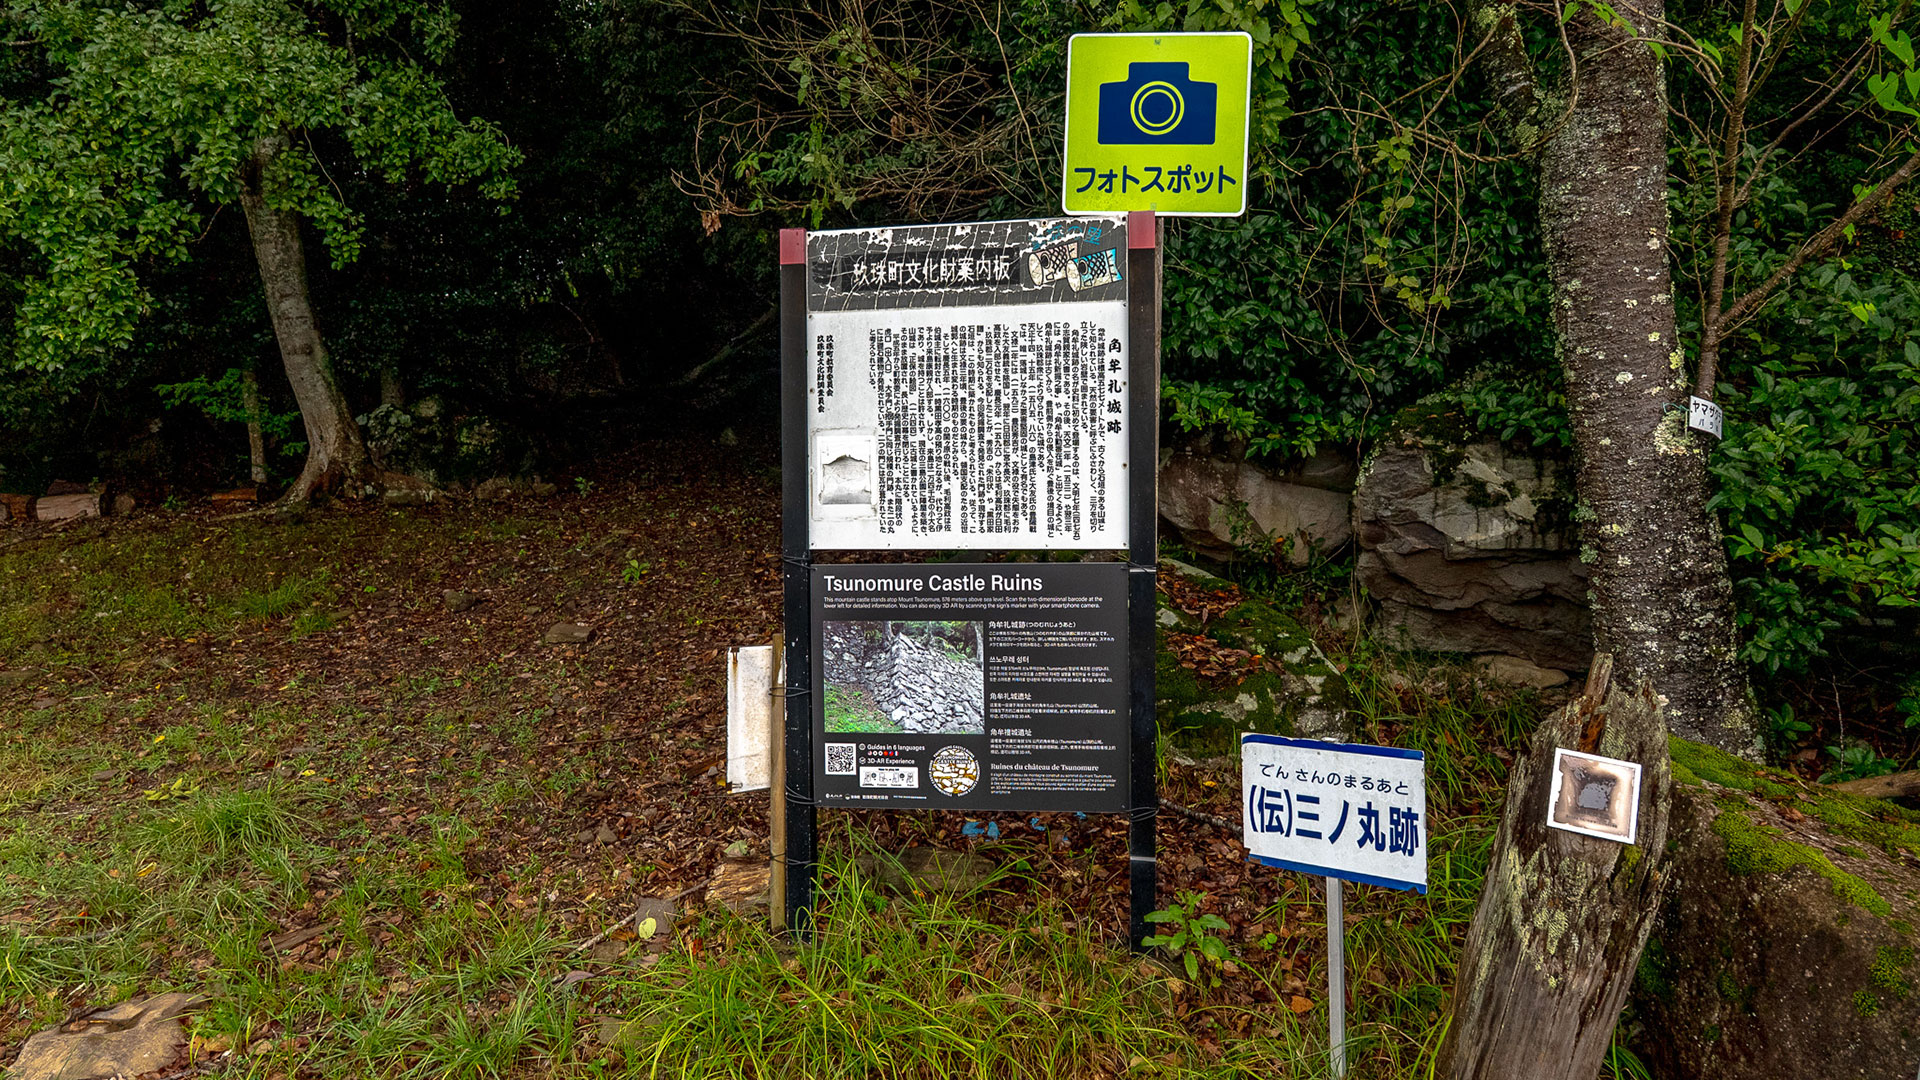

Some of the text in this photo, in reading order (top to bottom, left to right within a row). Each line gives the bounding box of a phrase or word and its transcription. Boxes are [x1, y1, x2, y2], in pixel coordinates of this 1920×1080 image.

[1074, 163, 1237, 194] フォトスポット
[851, 254, 1010, 286] 玖珠町文化財案内板
[1107, 338, 1122, 434] 角牟礼城跡
[824, 574, 1042, 591] Tsunomure Castle Ruins
[1259, 763, 1409, 796] でん さんのまるあと
[1249, 784, 1420, 857] (伝)三ノ丸跡
